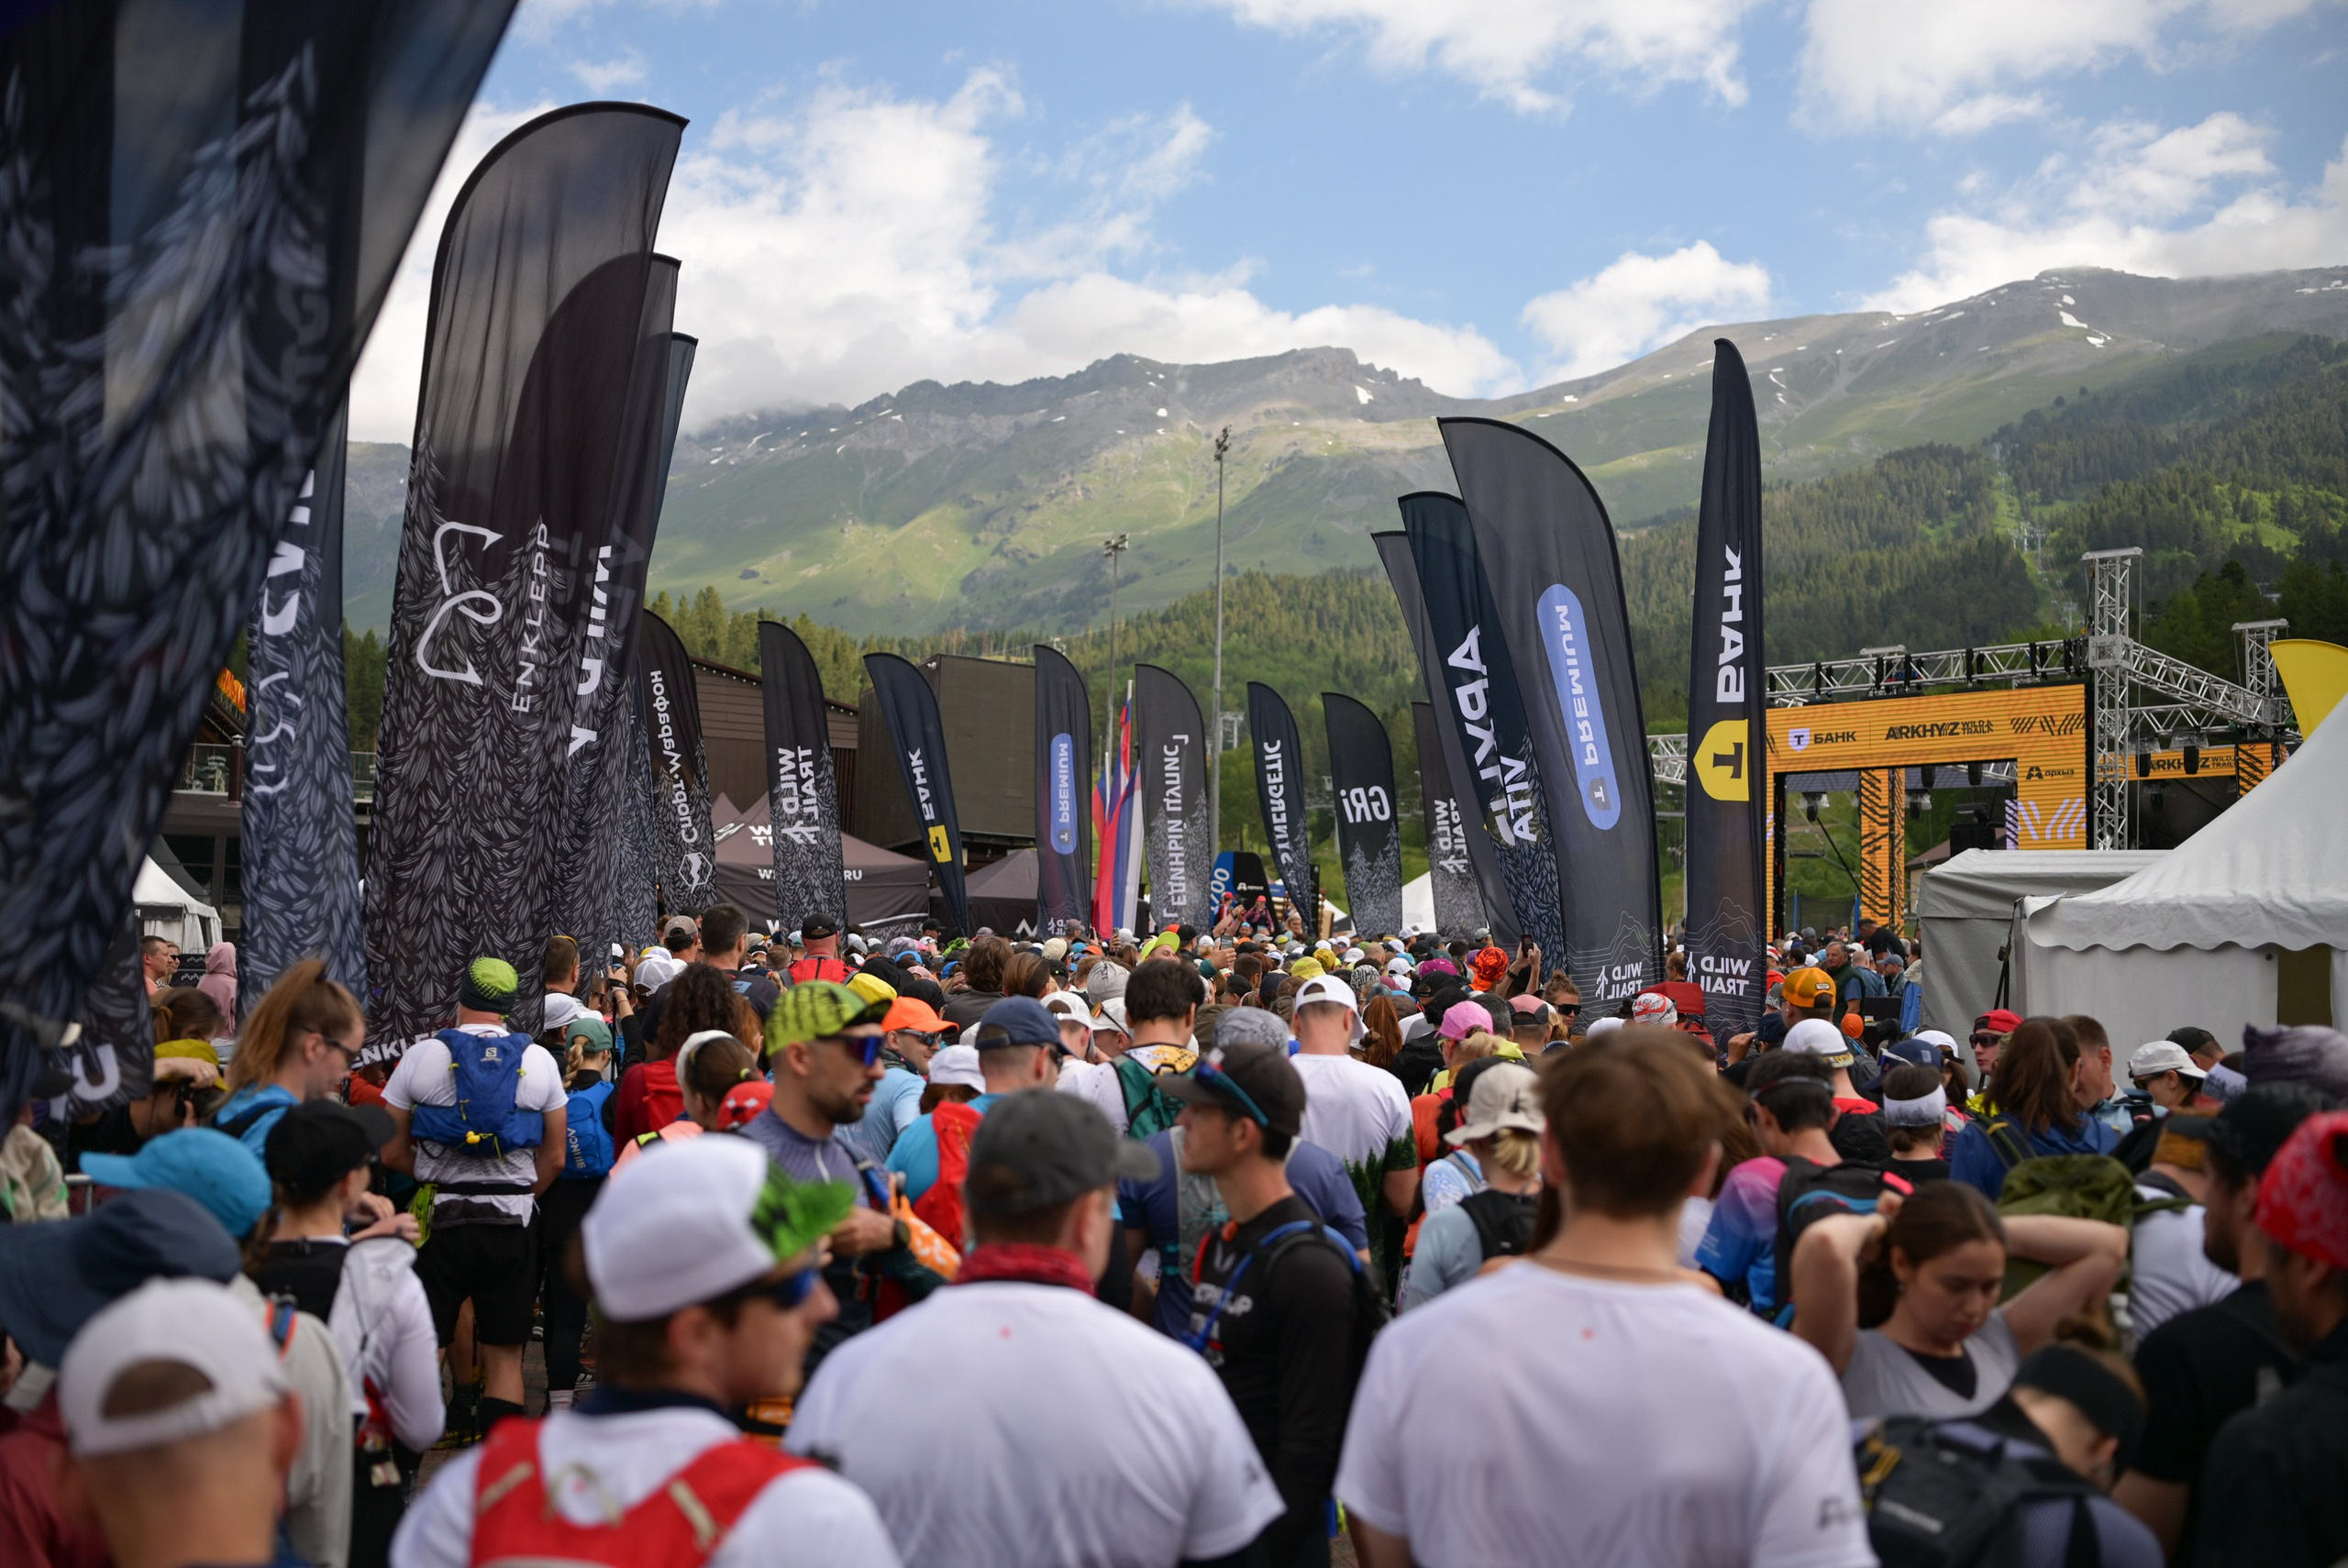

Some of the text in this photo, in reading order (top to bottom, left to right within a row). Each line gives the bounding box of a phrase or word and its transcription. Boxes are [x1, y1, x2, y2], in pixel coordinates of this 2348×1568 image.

[512, 523, 550, 713] ENKLEPP
[1885, 722, 1960, 740] ARKHYZ
[1961, 720, 1986, 728] WILD
[1961, 726, 1988, 735] TRAIL
[1813, 731, 1857, 745] БАНК
[2148, 757, 2210, 771] ARKHZ
